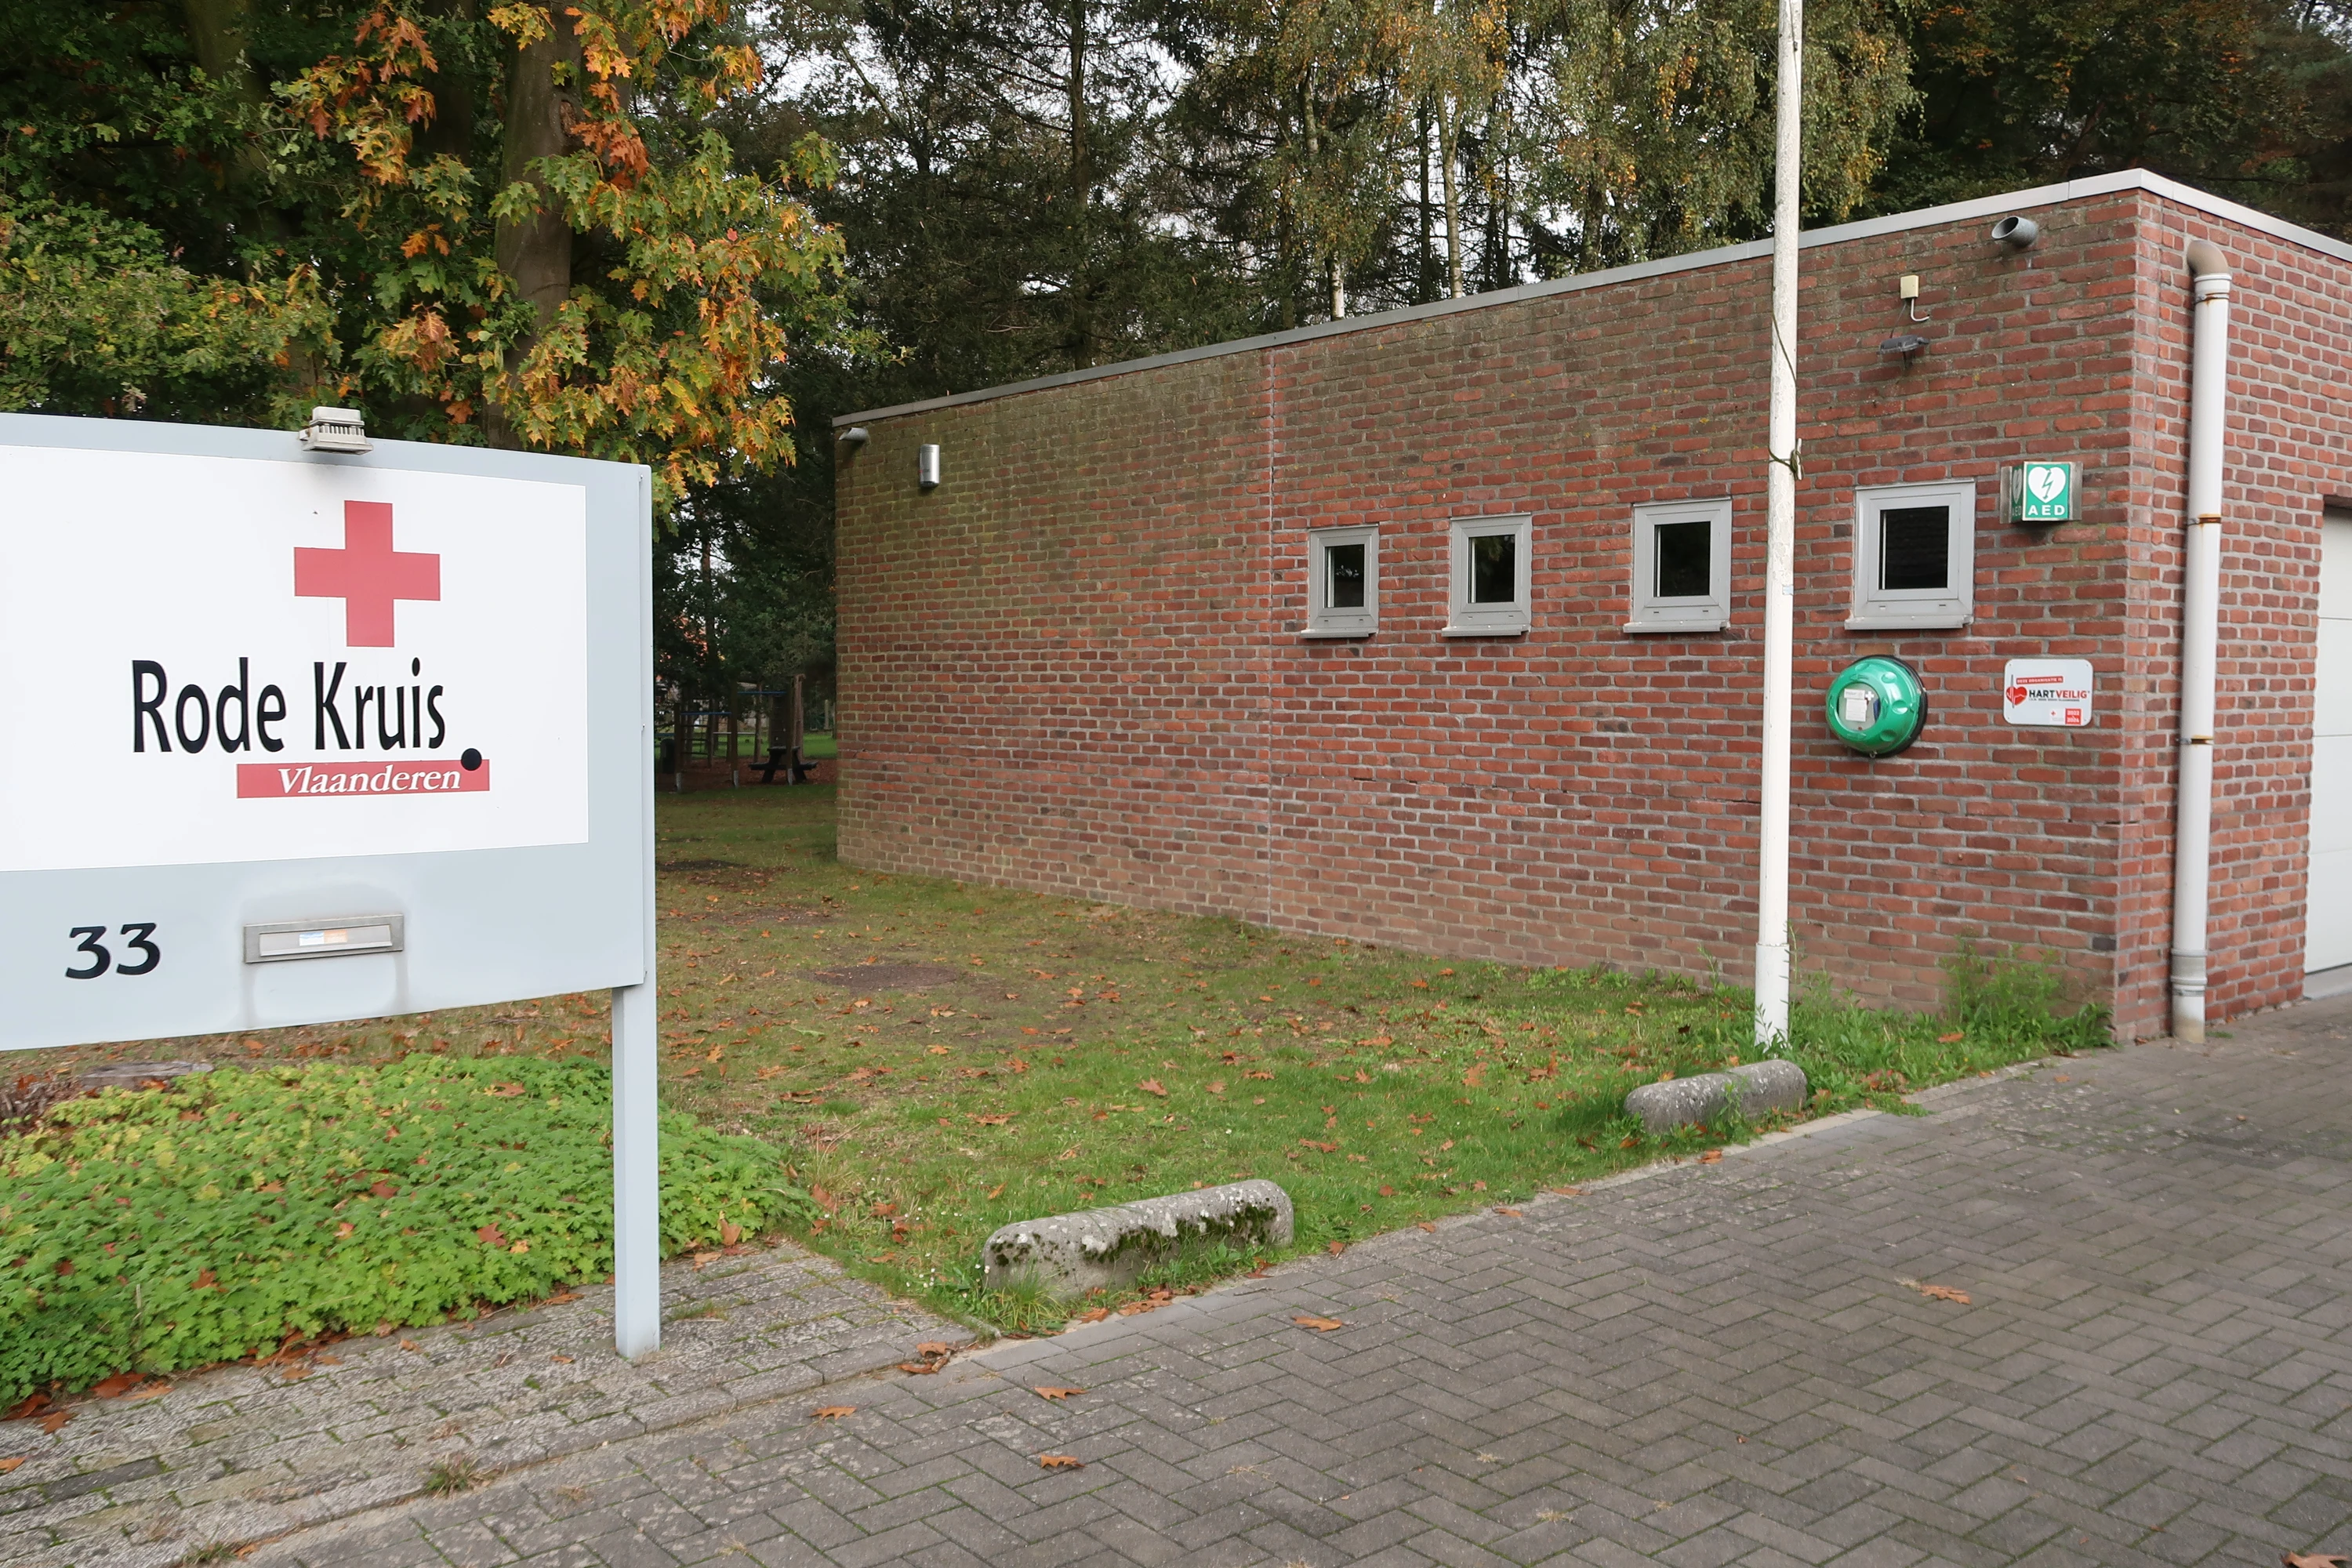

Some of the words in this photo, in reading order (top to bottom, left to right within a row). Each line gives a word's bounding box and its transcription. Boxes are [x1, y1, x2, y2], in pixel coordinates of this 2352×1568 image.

[2027, 504, 2066, 517] AED
[132, 656, 286, 754] Rode
[314, 657, 446, 751] Kruis
[278, 764, 462, 794] Vlaanderen
[65, 922, 161, 980] 33
